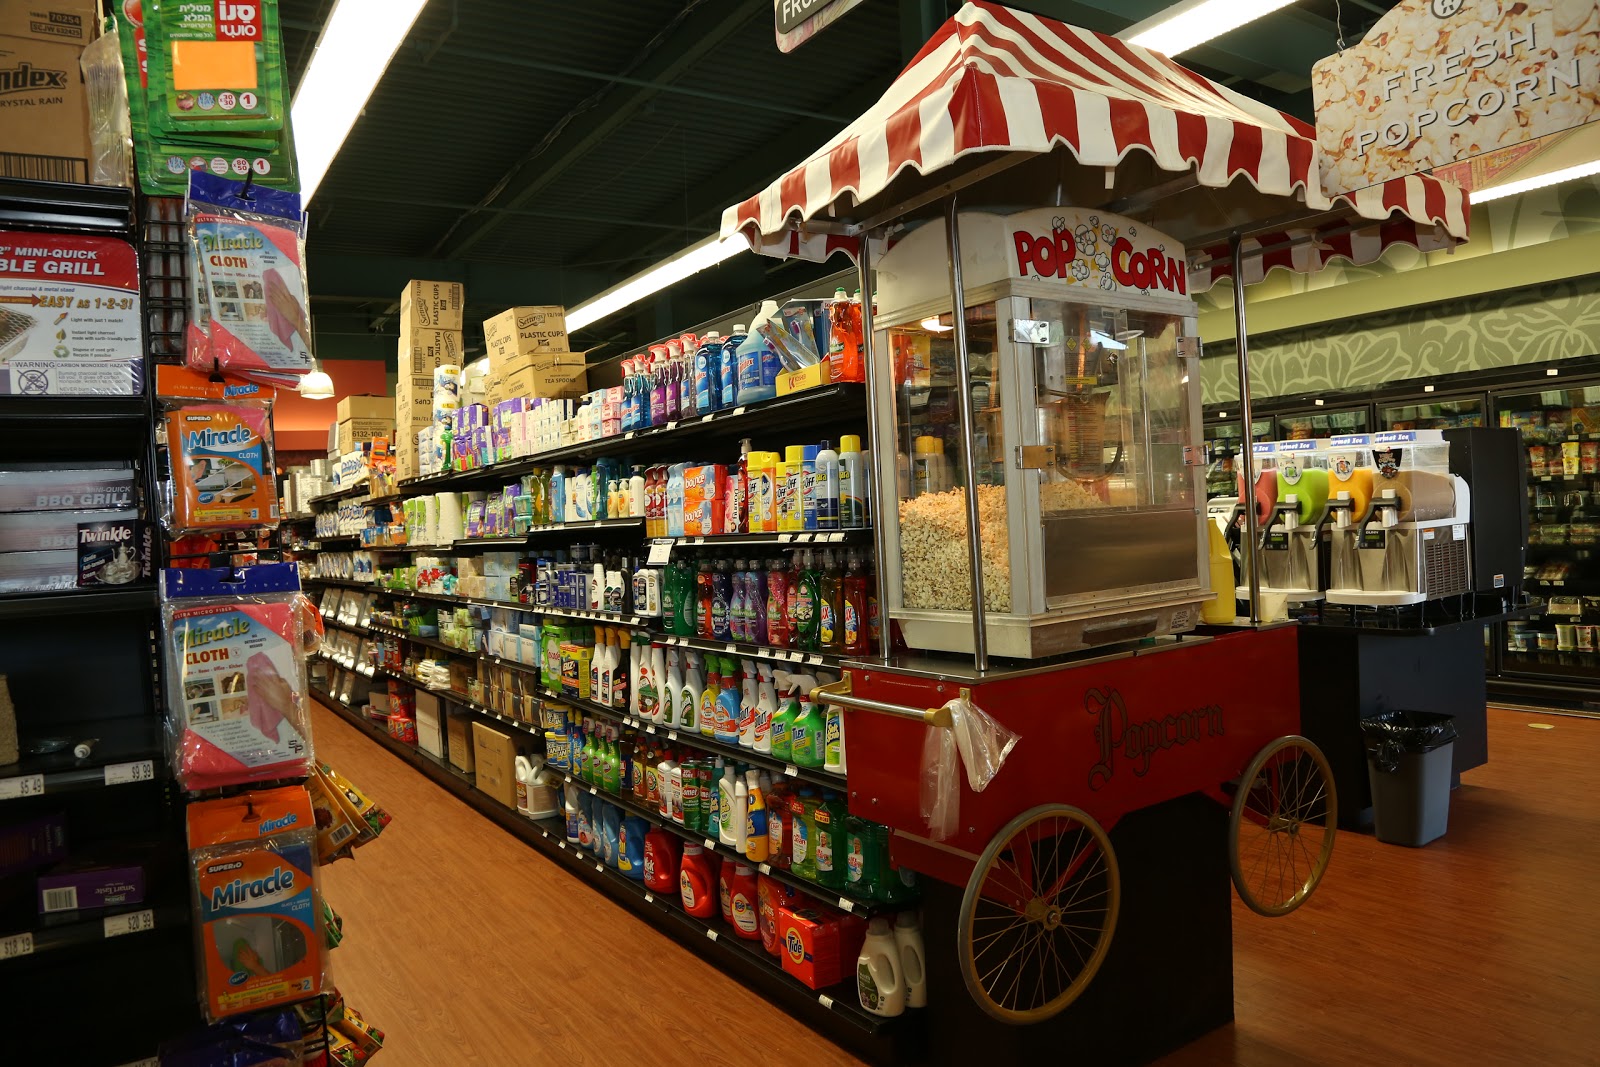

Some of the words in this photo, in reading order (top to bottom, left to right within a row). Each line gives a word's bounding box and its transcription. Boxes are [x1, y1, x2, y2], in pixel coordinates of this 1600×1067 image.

[1383, 22, 1538, 102] FRESH
[40, 97, 62, 106] RAIN
[1357, 58, 1582, 158] POPCORN
[203, 232, 264, 252] Miracle
[15, 247, 97, 259] MINI-QUICK
[1013, 227, 1076, 279] POP
[43, 260, 105, 276] GRILL
[210, 255, 248, 268] CLOTH
[1111, 236, 1186, 296] CORN
[39, 295, 74, 308] EASY
[76, 299, 91, 308] AS
[95, 297, 133, 310] 1-2-3!
[224, 383, 259, 397] Miracle
[189, 424, 251, 449] Miracle
[686, 474, 705, 488] bounce
[36, 495, 74, 507] BBQ
[80, 494, 131, 505] GRILL
[685, 508, 703, 522] bounce
[80, 526, 132, 543] Twinkle
[142, 528, 153, 578] Twinkle
[186, 648, 229, 664] CLOTH
[563, 661, 574, 671] BIZ
[1084, 685, 1225, 791] Popcorn
[259, 813, 297, 835] Miracle
[211, 867, 294, 912] Miracle
[292, 902, 310, 911] CLOTH
[788, 936, 803, 954] Tide
[303, 980, 310, 990] 2
